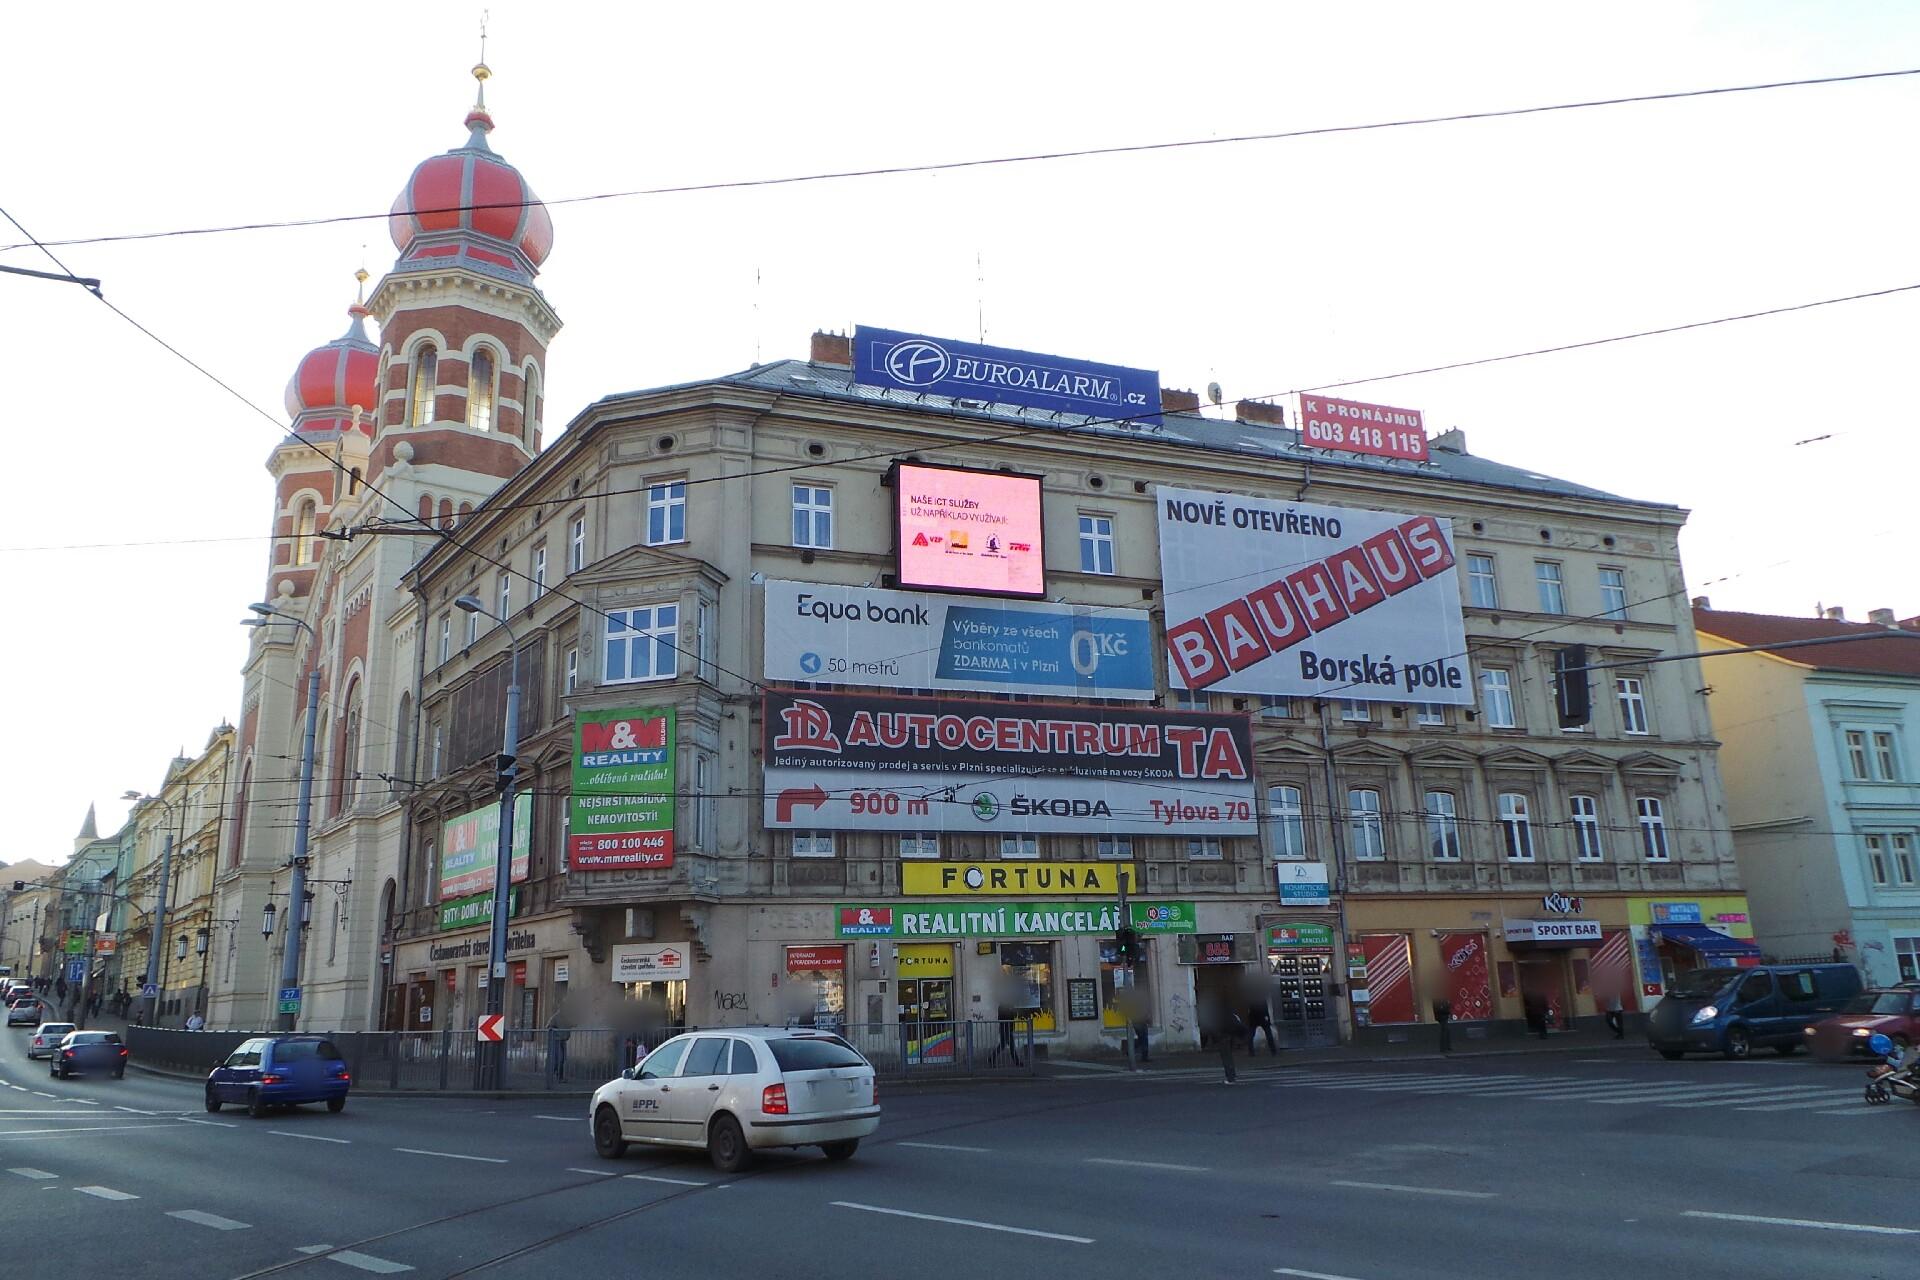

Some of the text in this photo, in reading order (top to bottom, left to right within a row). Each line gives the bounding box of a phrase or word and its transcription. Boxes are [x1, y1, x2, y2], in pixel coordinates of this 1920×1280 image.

[953, 358, 1112, 400] EUROALARM
[1307, 400, 1418, 427] K PRONÁJMU
[1309, 420, 1421, 454] 603 418 115
[910, 495, 933, 505] NAŠE
[949, 499, 979, 509] SLUŽBY
[1167, 499, 1342, 539] NOVĚ OTEVŘENO
[798, 594, 929, 625] Equa bank
[1171, 521, 1445, 680] BAUHAUS
[953, 619, 1059, 640] Výběry ze všech
[954, 637, 1029, 654] bankomatů
[1070, 630, 1128, 676] 0 Kč
[828, 658, 899, 676] 50 metrů
[954, 654, 1010, 670] ZDARMA
[1020, 661, 1029, 670] v
[1300, 650, 1462, 693] Borská pole
[846, 711, 1160, 757] AUTOCENTRUM
[1165, 725, 1247, 779] TA
[583, 751, 664, 766] REALITY
[775, 756, 807, 768] Jediný
[810, 759, 875, 771] autorizovaný
[879, 760, 910, 772] prodej
[920, 762, 949, 771] servis
[1110, 768, 1121, 777] na
[1123, 770, 1143, 779] vozy
[1145, 766, 1174, 778] ŠKODA
[850, 793, 929, 816] 900 m
[1010, 794, 1112, 817] ŠKODA
[1150, 800, 1250, 825] Tylova 70
[597, 836, 664, 850] 800 100 446
[578, 852, 664, 864] www.mmreality.cz
[943, 867, 1100, 890] FORTUNA
[443, 906, 457, 923] BYTY
[461, 902, 480, 920] DOMY
[903, 908, 1005, 934] REALITNÍ
[842, 926, 891, 934] REALITY
[1538, 925, 1597, 935] SPORT BAR
[900, 957, 948, 965] FORTUNA
[640, 1100, 659, 1108] PPL
